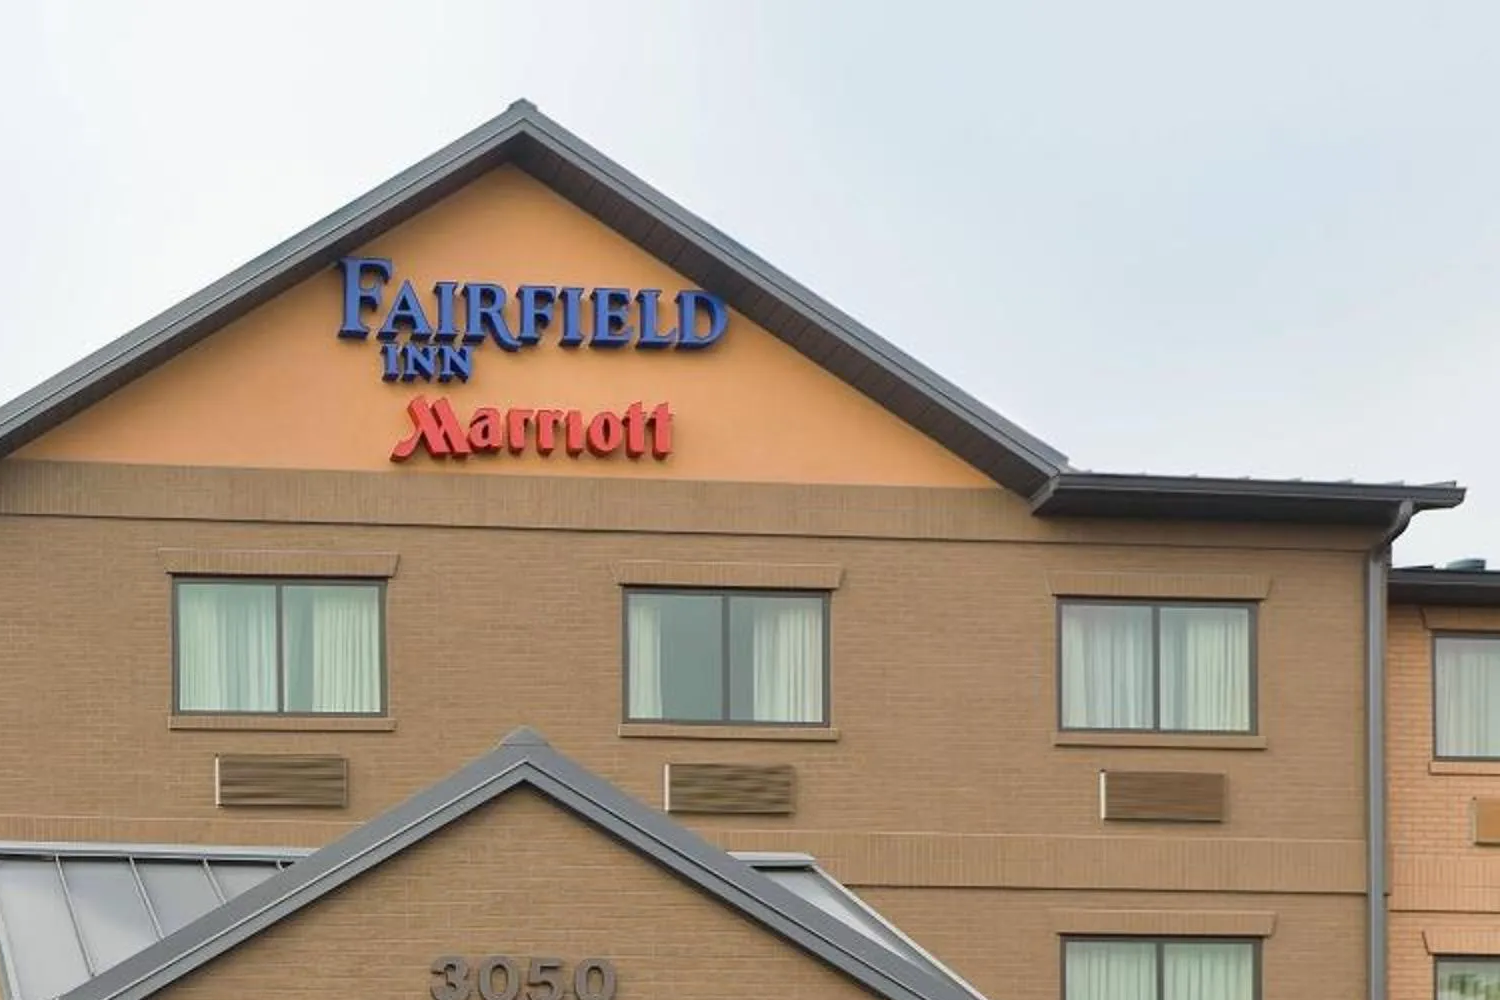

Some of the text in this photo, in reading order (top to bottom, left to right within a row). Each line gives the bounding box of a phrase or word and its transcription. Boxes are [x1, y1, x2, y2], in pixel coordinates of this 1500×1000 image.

[338, 256, 730, 352] FAIRFIELD
[380, 343, 475, 383] INN
[389, 394, 677, 462] Marriott
